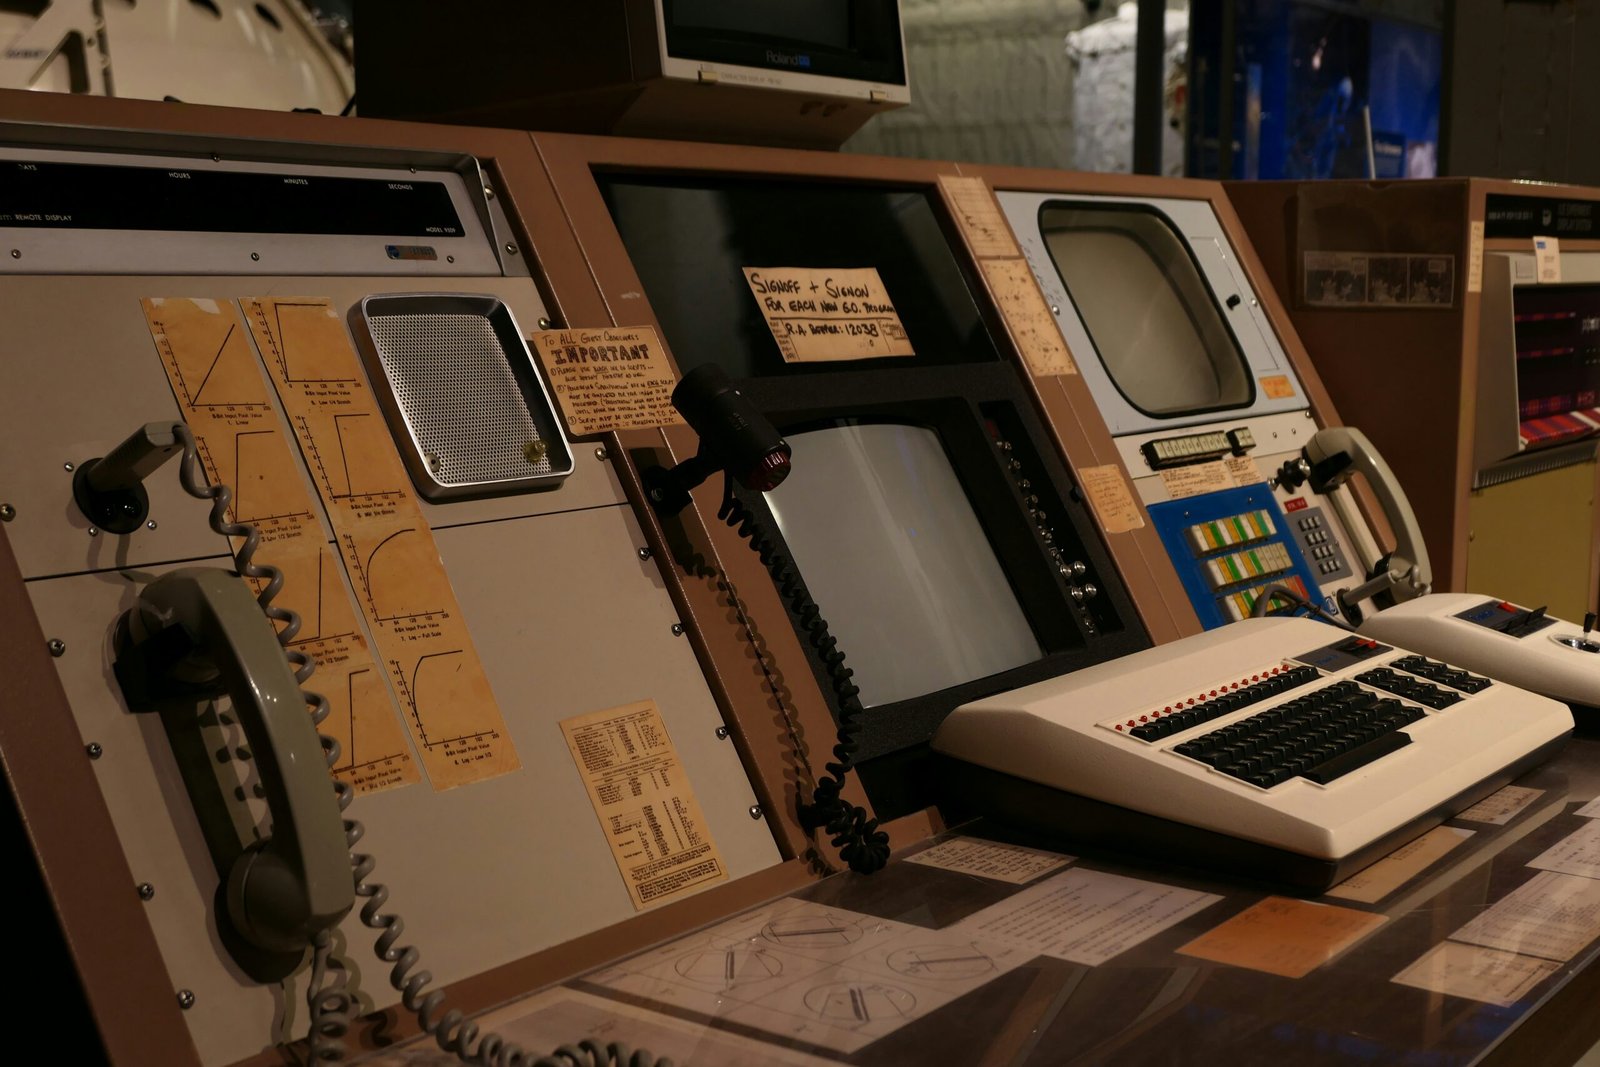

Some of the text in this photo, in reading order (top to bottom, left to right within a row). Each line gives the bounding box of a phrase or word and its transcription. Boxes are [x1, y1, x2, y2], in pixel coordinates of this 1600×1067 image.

[766, 51, 799, 66] Roland
[169, 172, 191, 180] HOURS
[15, 213, 42, 221] REMOTE
[750, 272, 869, 299] SIGNOFF + SIGNON
[765, 297, 785, 317] FOR
[789, 300, 817, 313] EACH
[847, 323, 879, 337] 12038
[560, 333, 577, 347] ALL
[551, 343, 649, 365] IMPORTANT
